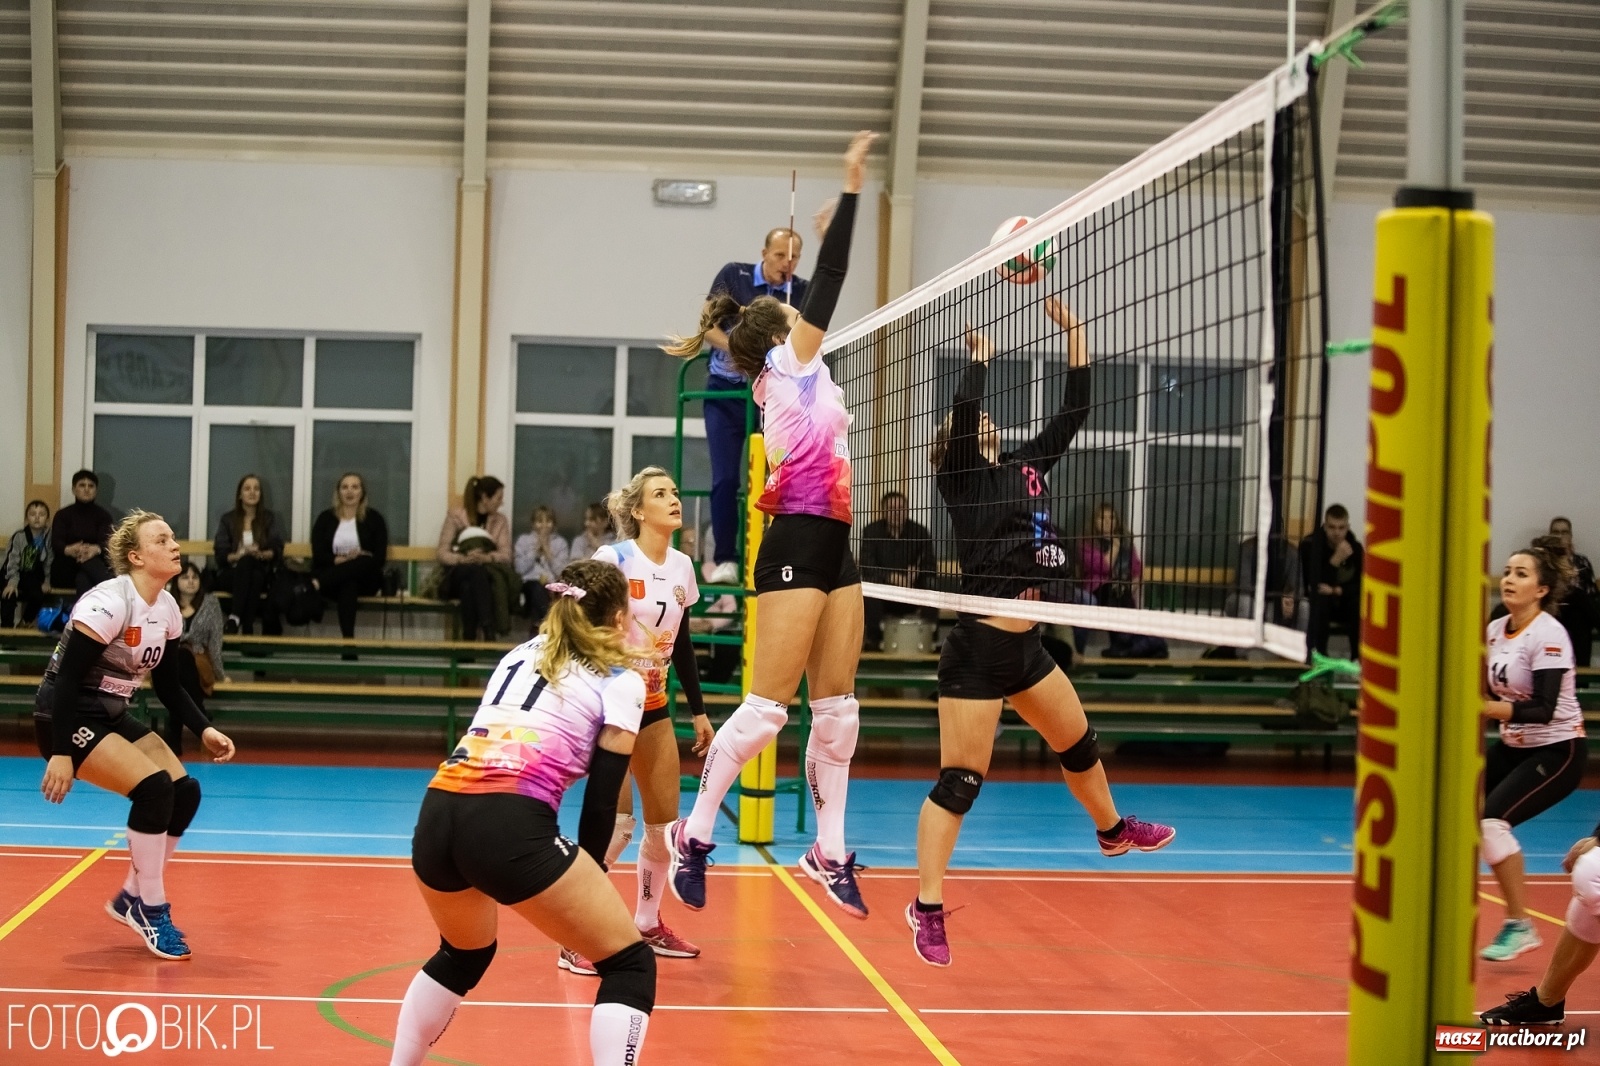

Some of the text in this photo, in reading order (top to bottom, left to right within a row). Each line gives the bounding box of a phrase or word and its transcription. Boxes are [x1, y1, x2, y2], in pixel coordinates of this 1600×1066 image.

[656, 601, 667, 627] 7
[137, 646, 161, 668] 99
[71, 726, 95, 748] 99
